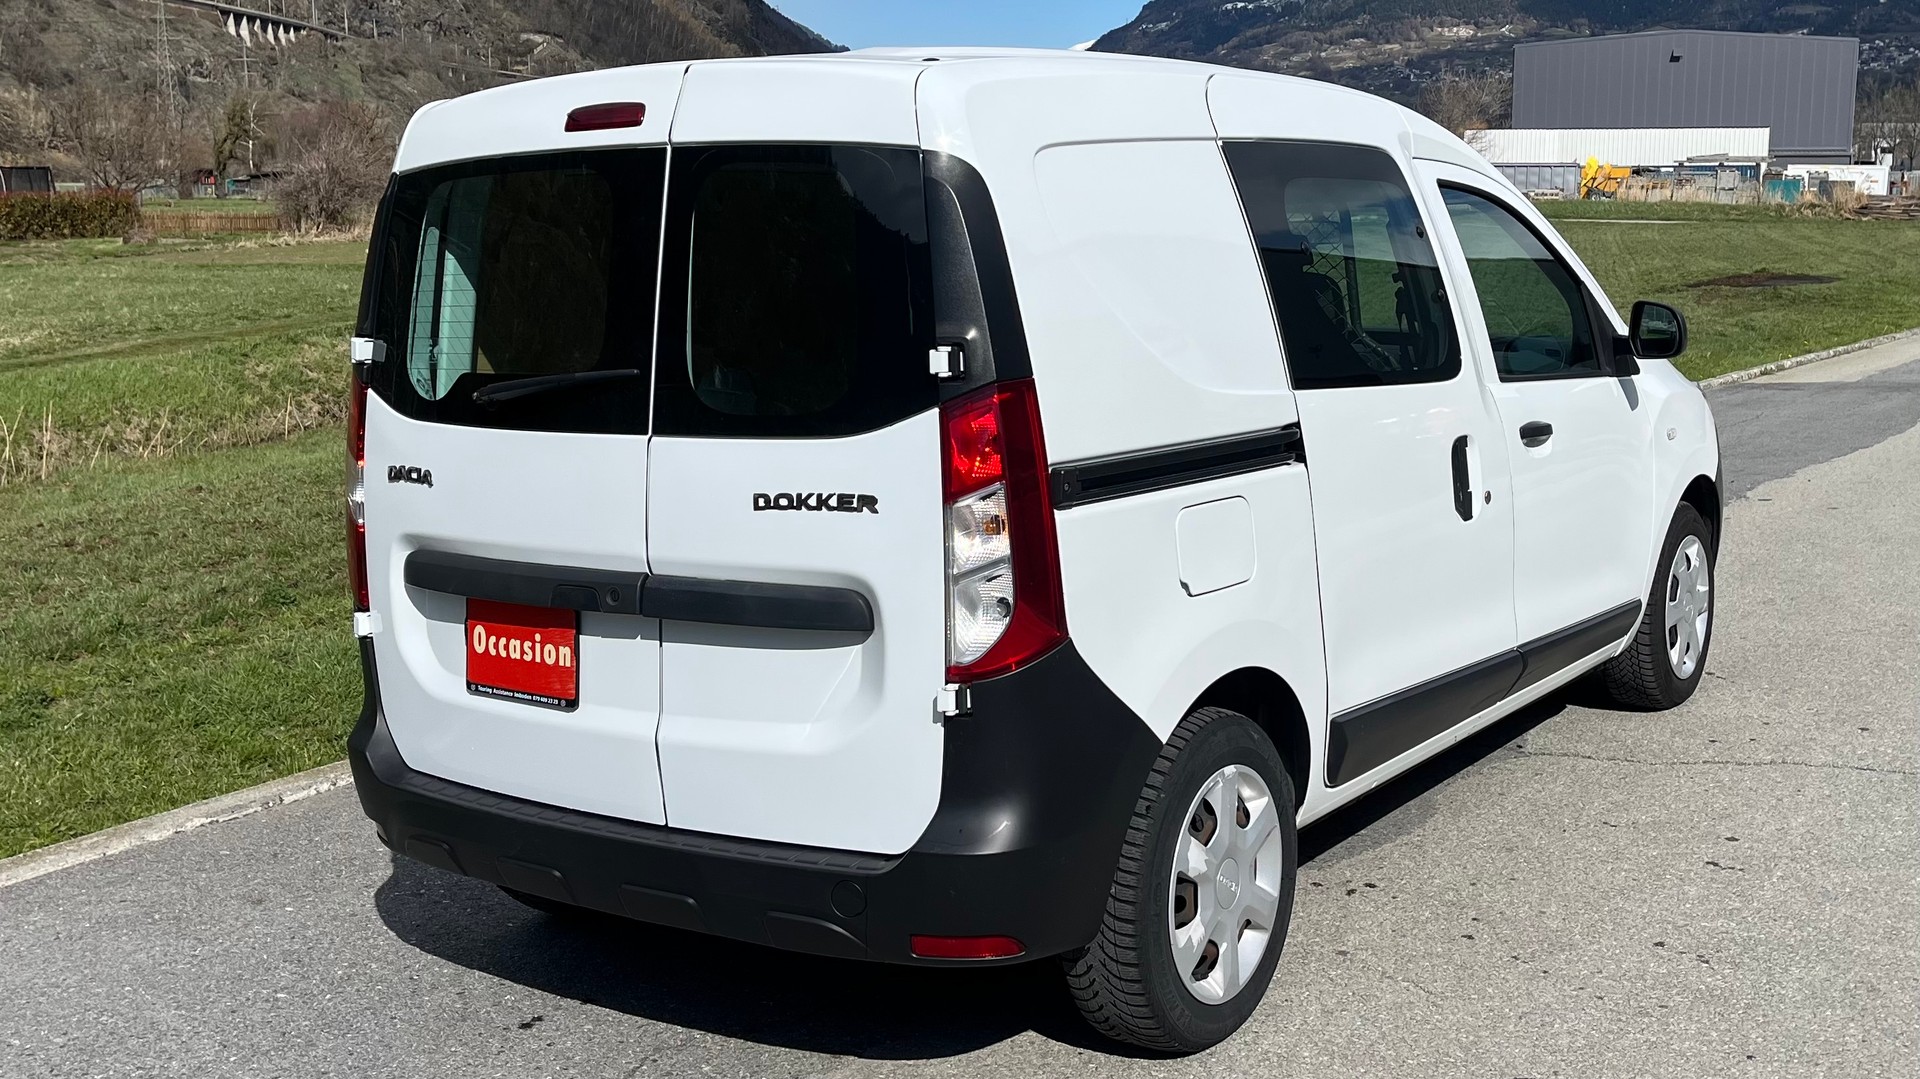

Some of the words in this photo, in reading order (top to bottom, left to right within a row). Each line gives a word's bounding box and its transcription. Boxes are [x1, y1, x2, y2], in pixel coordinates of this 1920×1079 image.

[388, 465, 433, 488] DACIA
[753, 493, 879, 514] DOKKER
[473, 624, 571, 667] Occasion
[478, 685, 492, 694] Touring
[493, 688, 513, 697] Assistance
